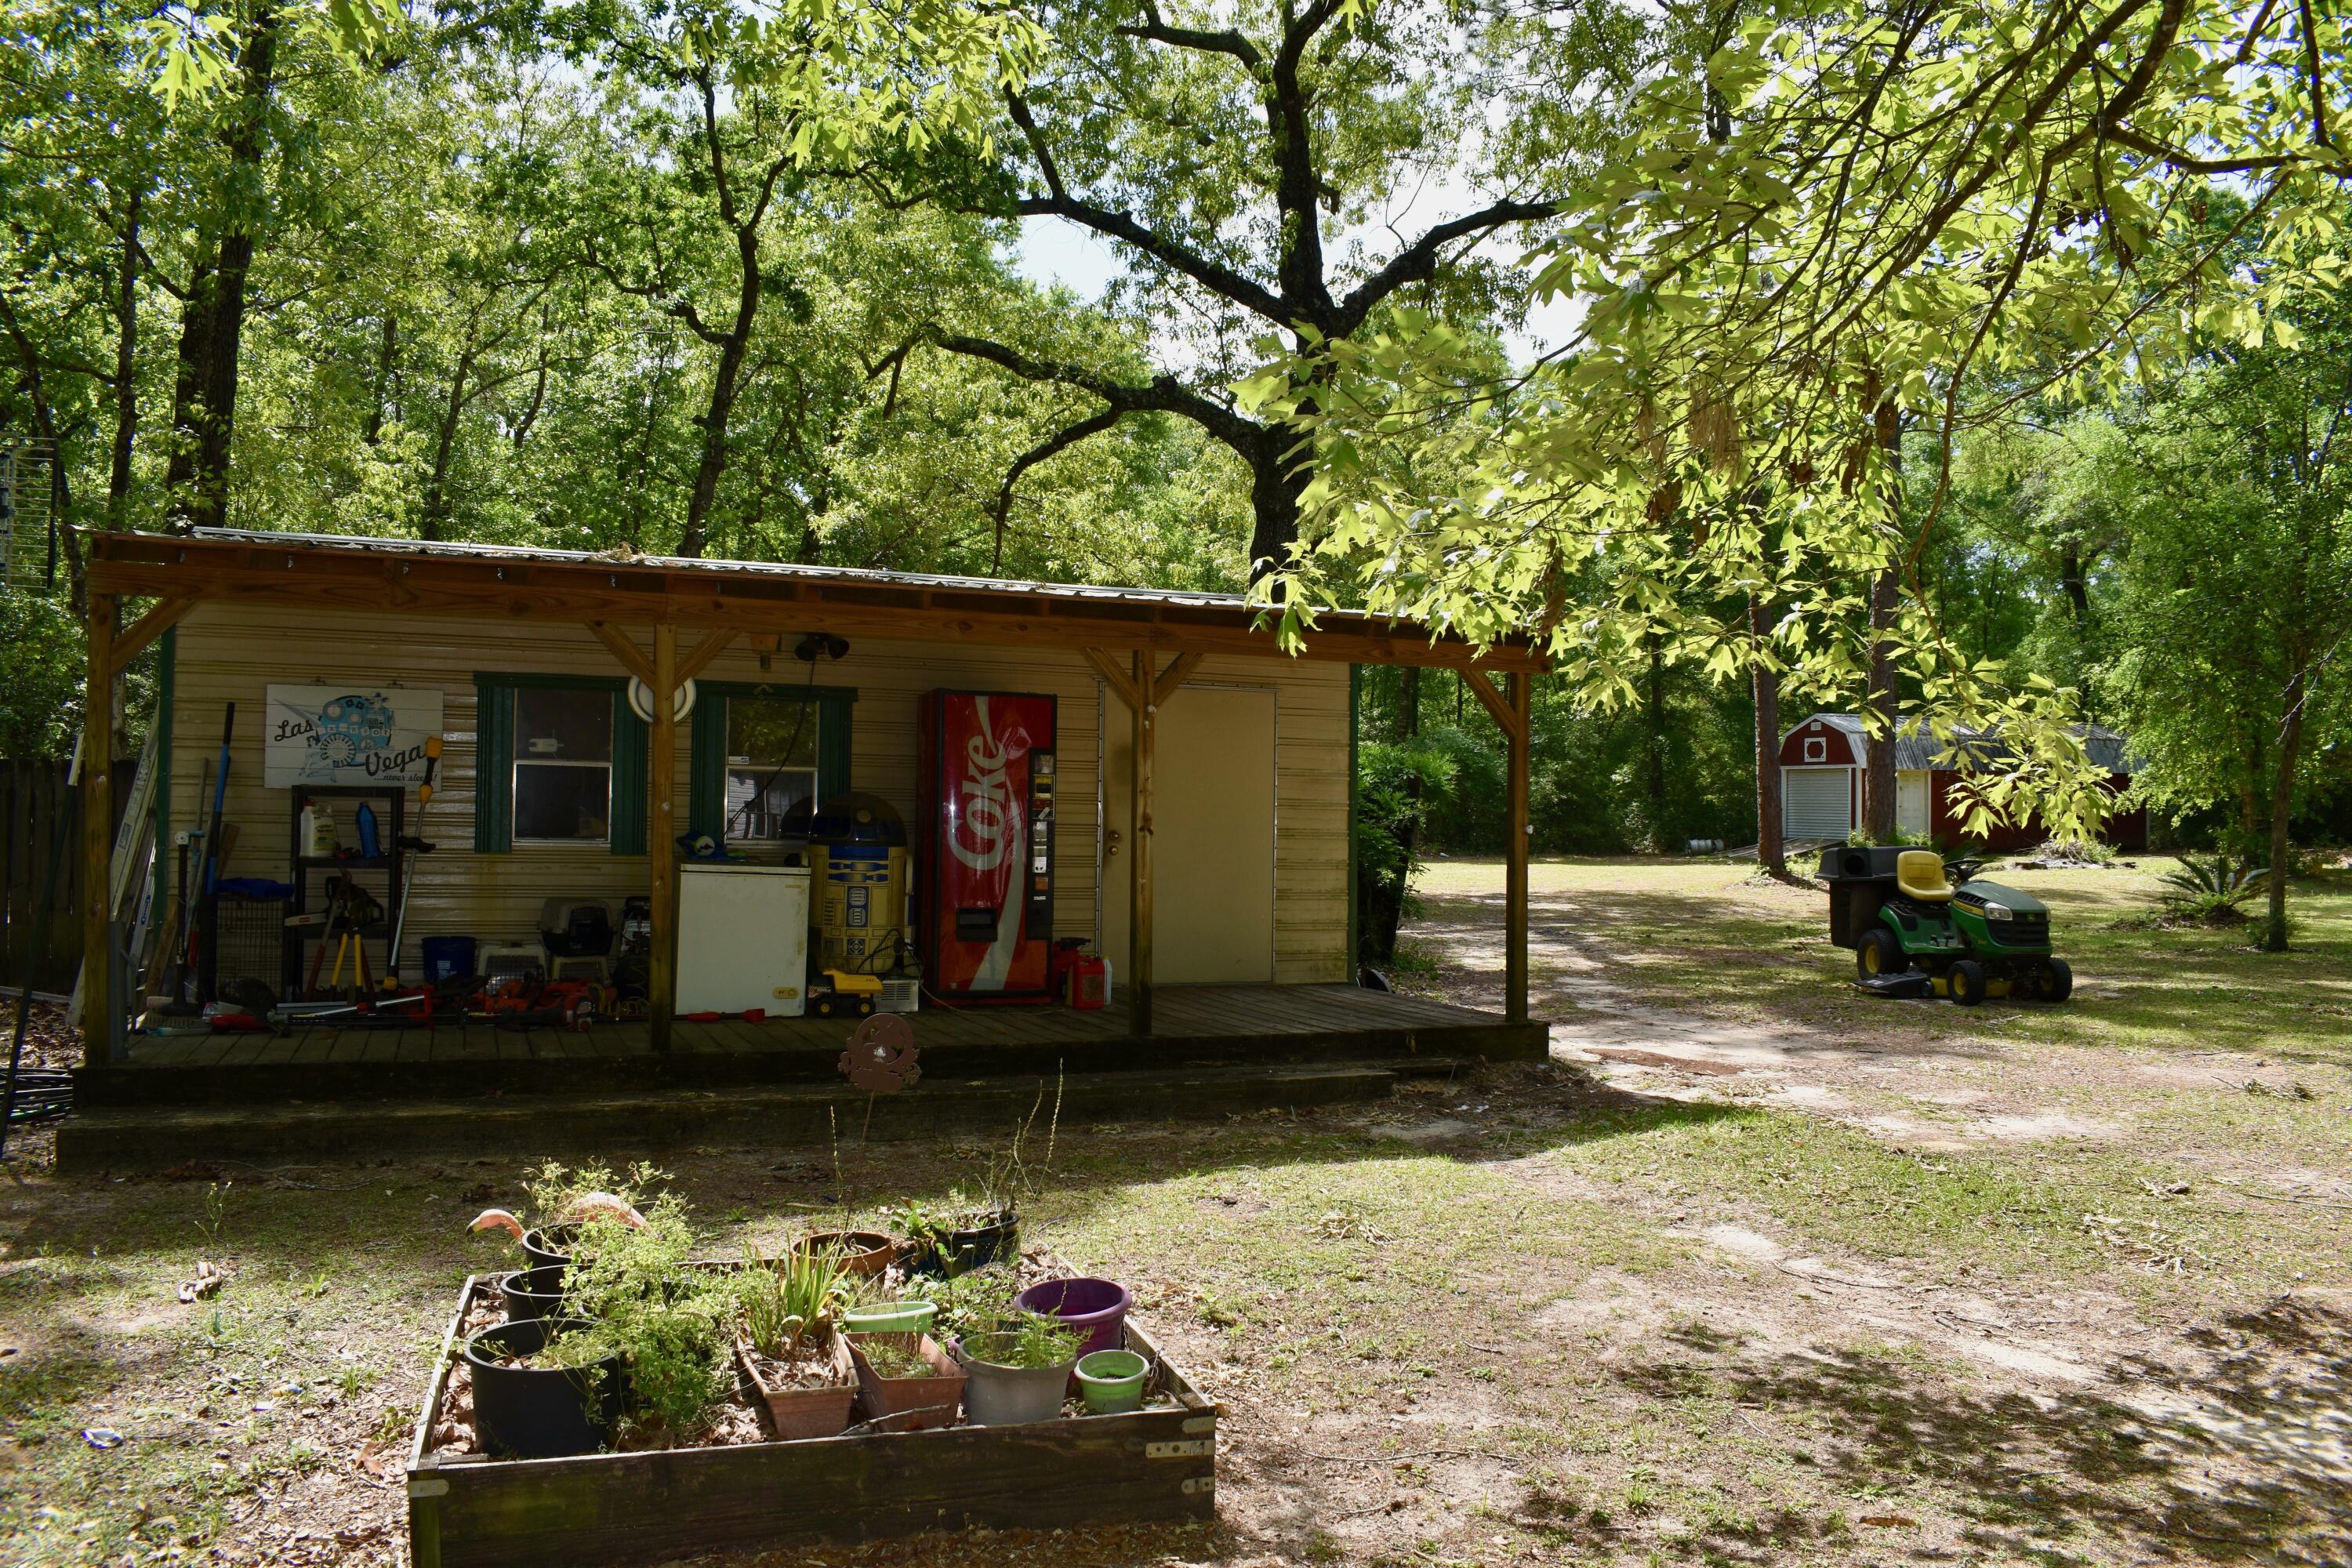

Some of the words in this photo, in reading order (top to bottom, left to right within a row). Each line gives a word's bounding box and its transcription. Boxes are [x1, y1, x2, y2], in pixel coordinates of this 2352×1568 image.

[274, 719, 314, 742] Las
[365, 745, 428, 776] Vega
[946, 734, 1007, 871] Coke
